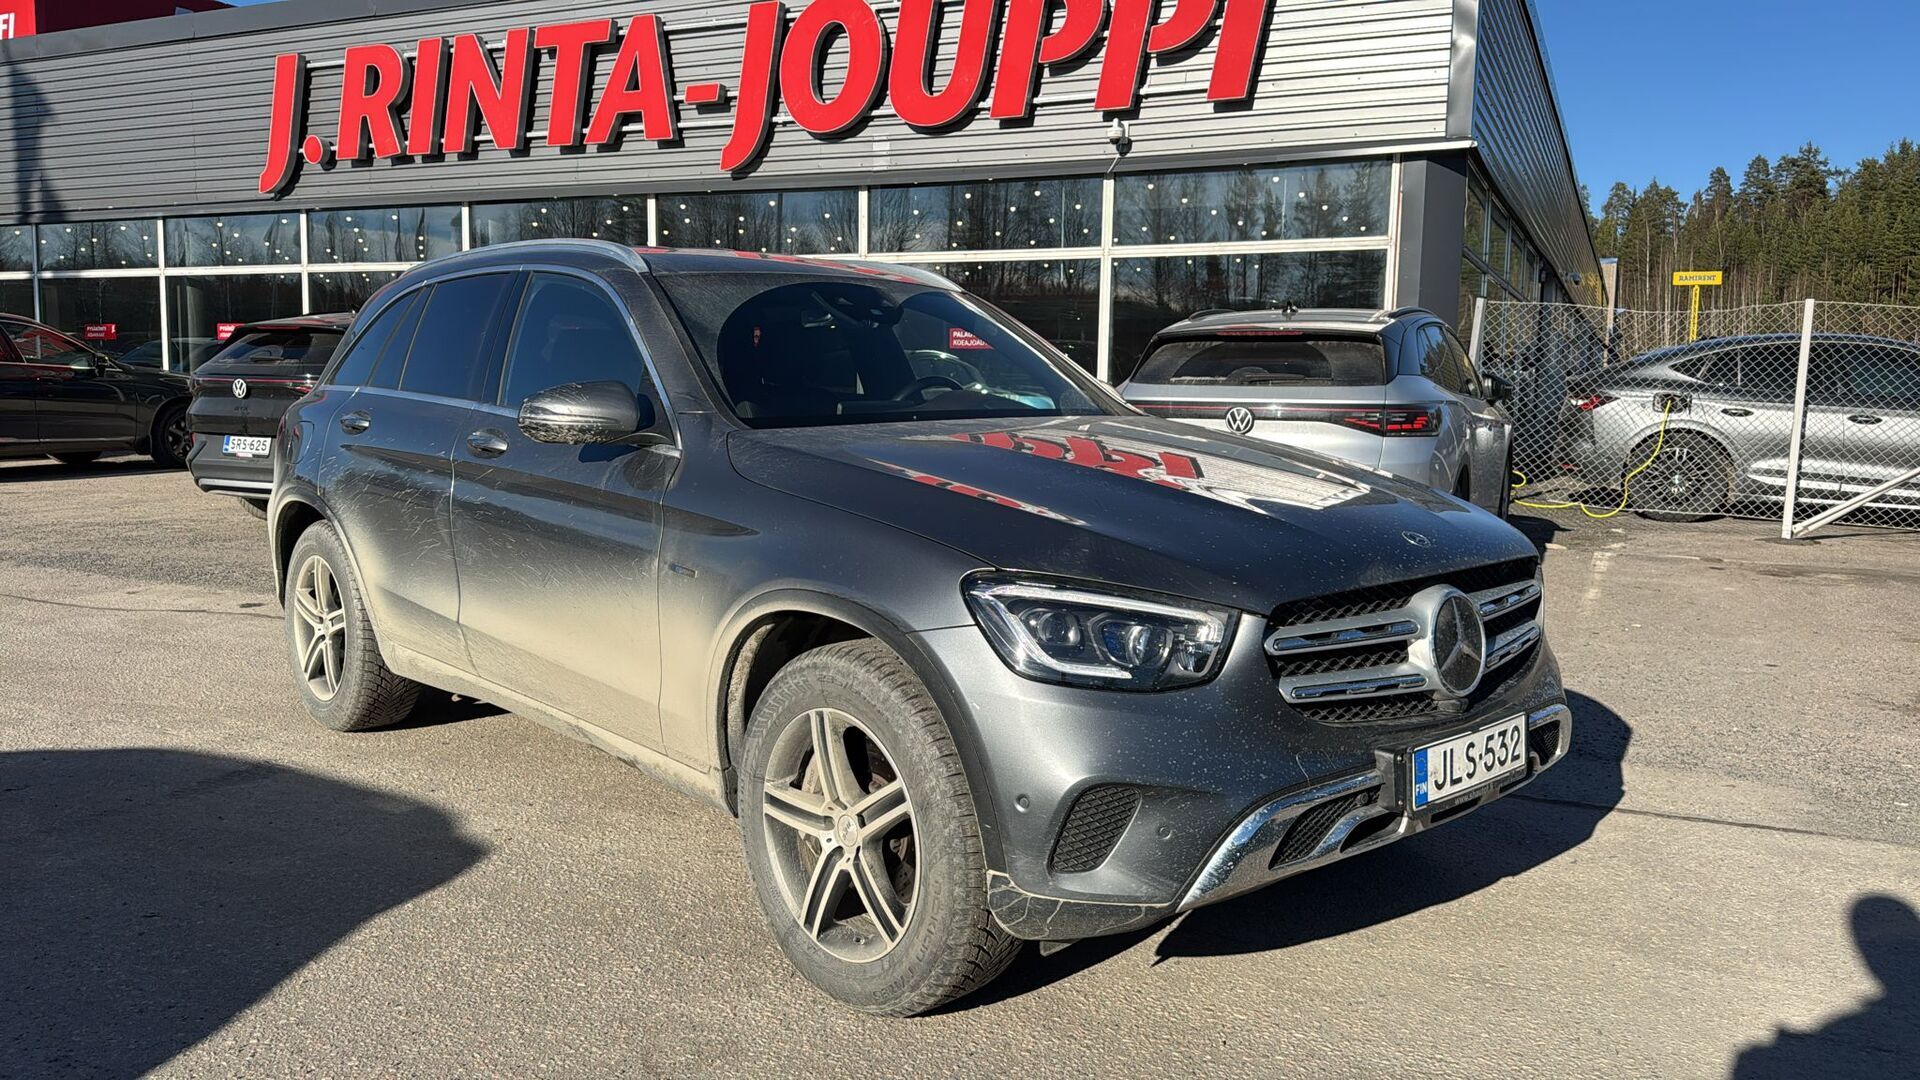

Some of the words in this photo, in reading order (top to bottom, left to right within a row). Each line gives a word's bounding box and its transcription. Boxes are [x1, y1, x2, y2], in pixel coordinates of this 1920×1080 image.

[231, 438, 267, 452] SRS-625
[1434, 724, 1520, 790] JLS-532
[1415, 780, 1427, 796] FIN
